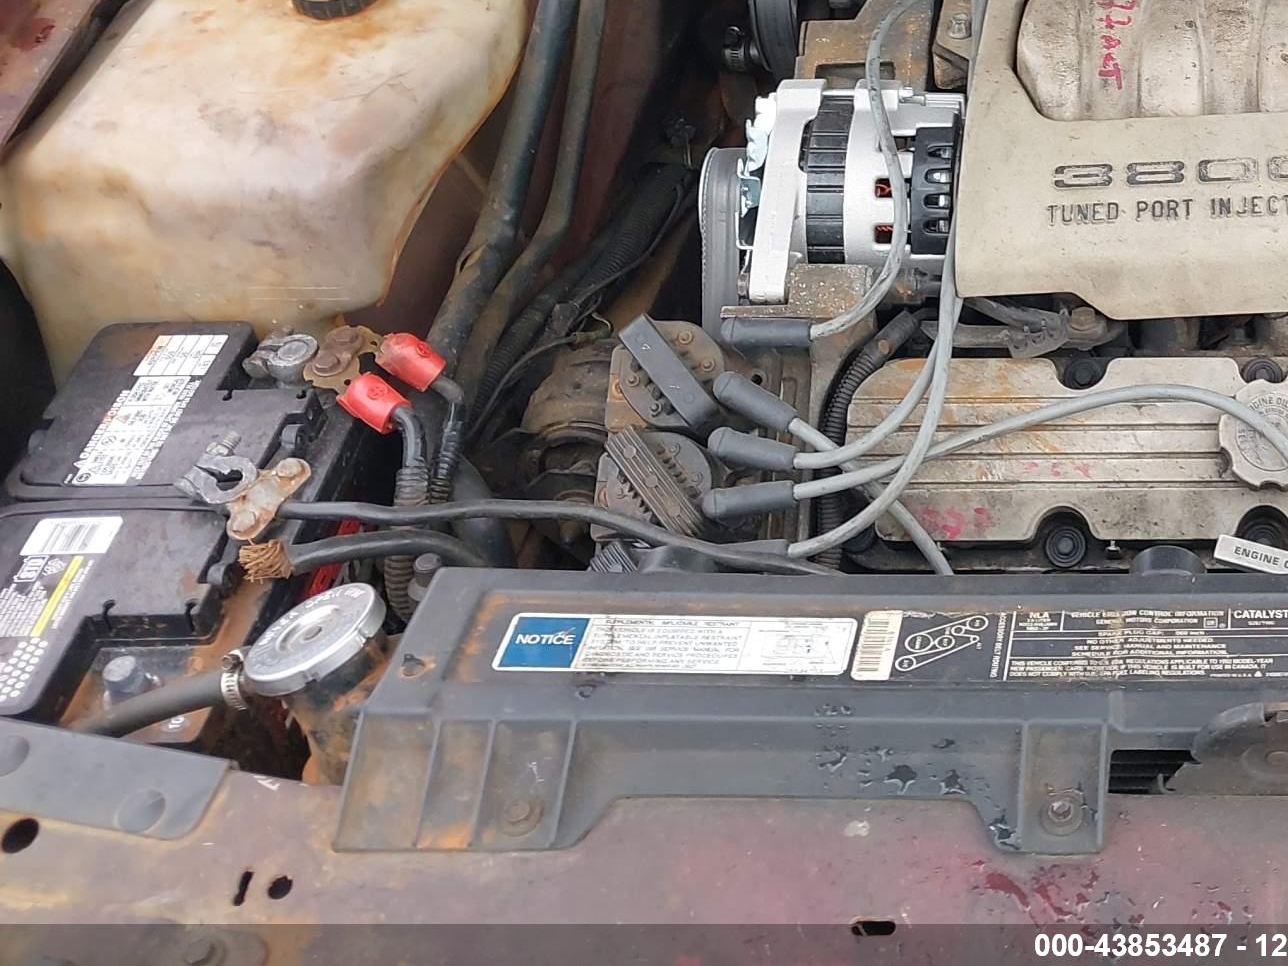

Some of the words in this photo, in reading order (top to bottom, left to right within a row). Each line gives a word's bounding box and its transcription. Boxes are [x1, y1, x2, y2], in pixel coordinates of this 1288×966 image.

[1047, 202, 1119, 225] TUNED
[1135, 199, 1193, 221] PORT
[1234, 546, 1281, 566] ENGINE
[515, 634, 577, 645] NOTICE
